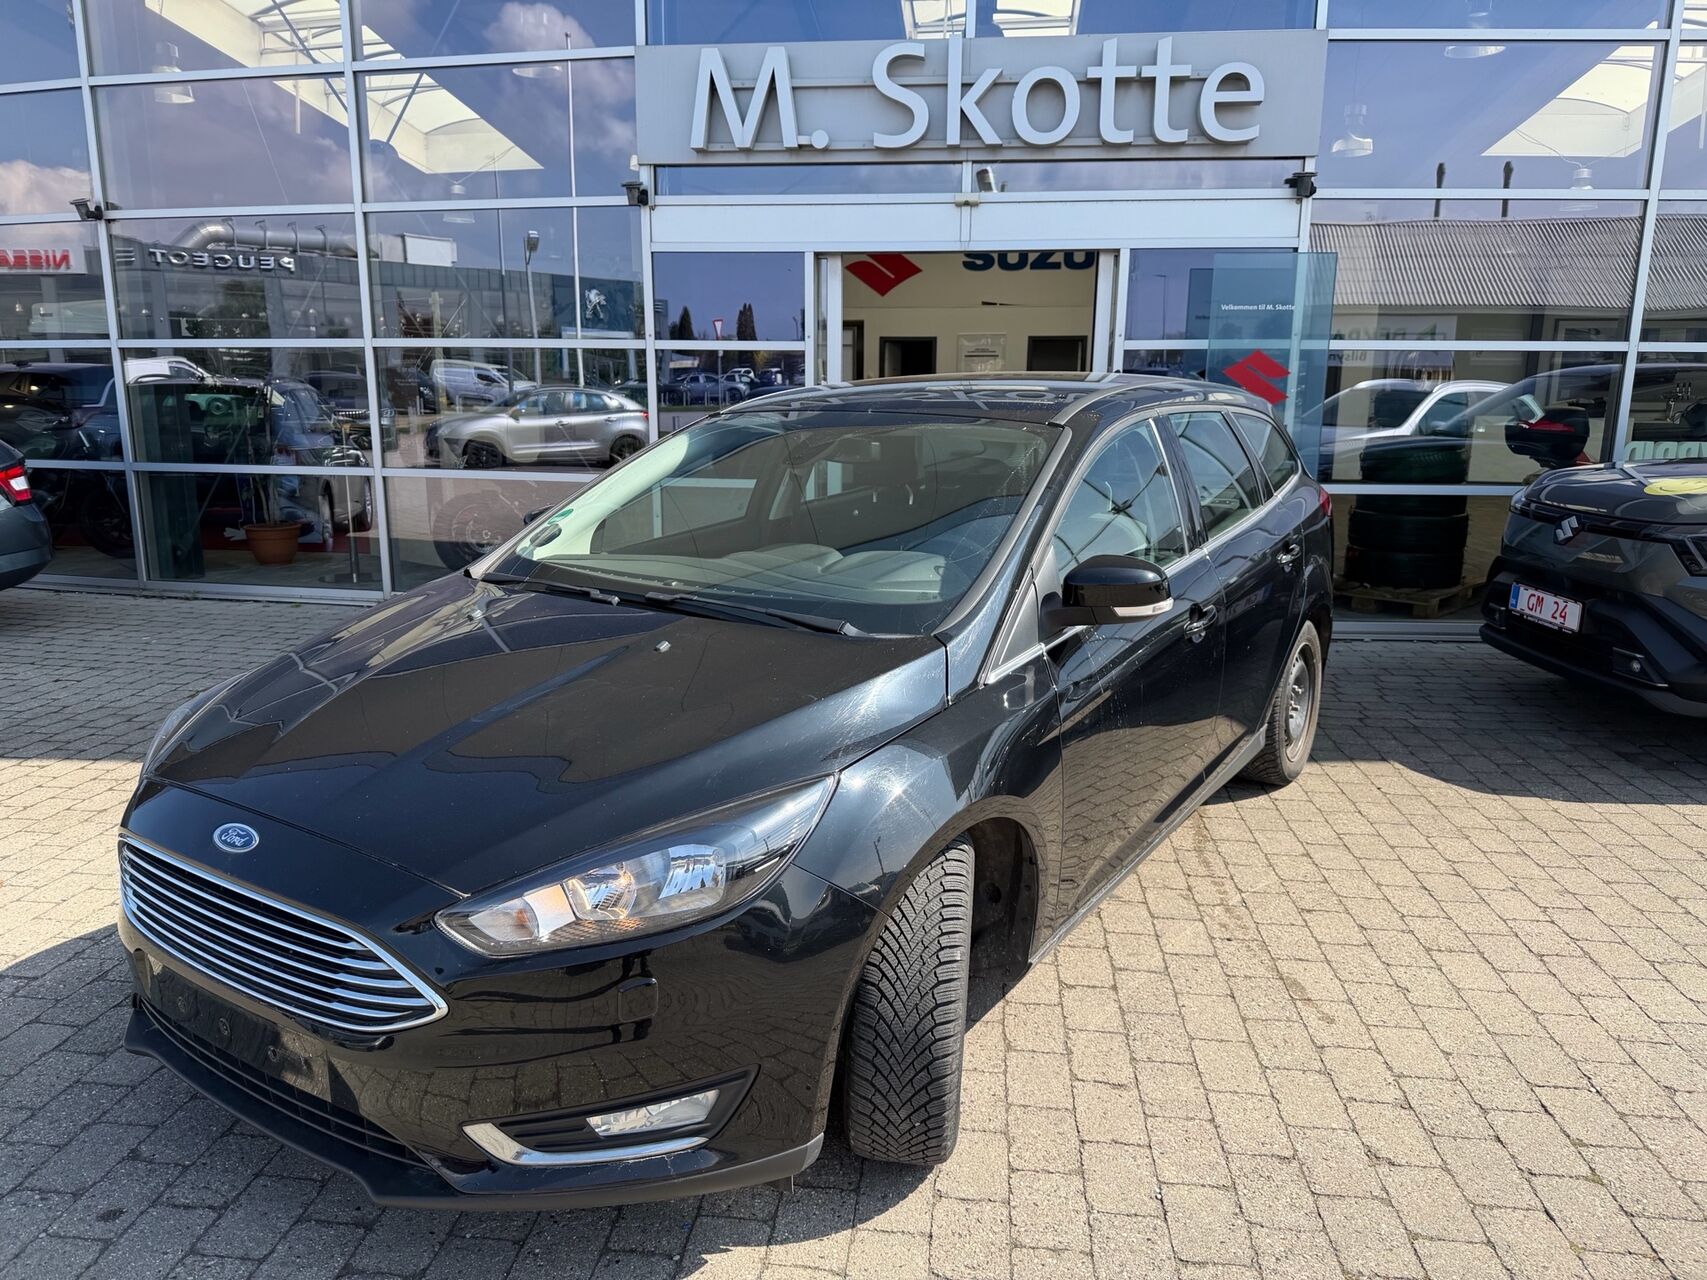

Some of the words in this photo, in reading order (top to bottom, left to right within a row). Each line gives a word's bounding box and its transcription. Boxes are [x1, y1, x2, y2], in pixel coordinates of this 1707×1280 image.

[690, 46, 829, 151] M.
[872, 34, 1264, 149] Skotte
[1220, 303, 1258, 311] Velkommen
[1275, 303, 1296, 311] Skotte
[1527, 593, 1544, 614] GM
[1551, 600, 1568, 622] 24
[220, 826, 250, 847] Ford
